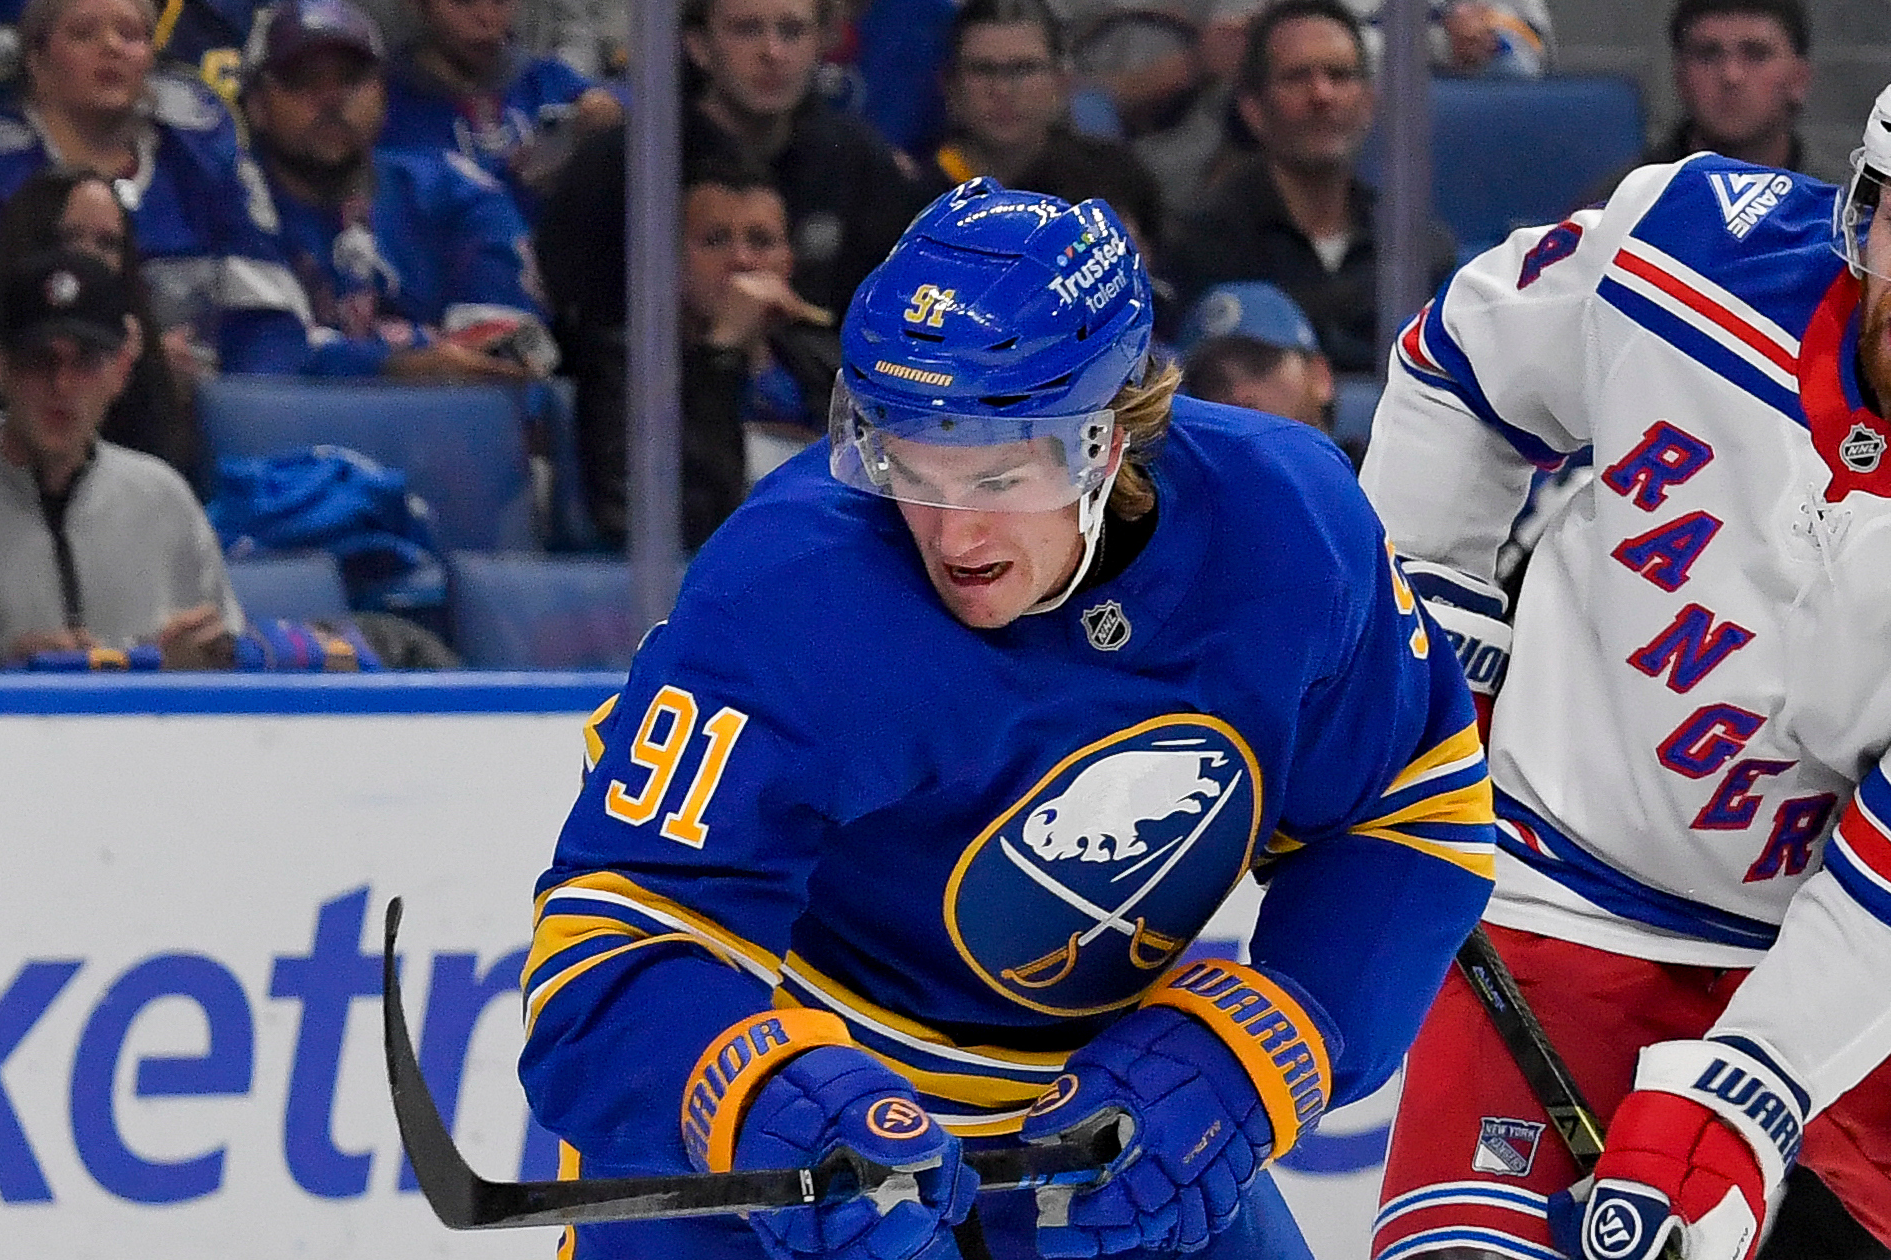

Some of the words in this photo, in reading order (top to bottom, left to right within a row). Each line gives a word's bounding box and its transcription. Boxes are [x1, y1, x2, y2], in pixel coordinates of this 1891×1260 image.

[1727, 175, 1793, 239] GAME
[1047, 226, 1127, 304] Trusted
[904, 284, 956, 328] 91
[1086, 267, 1127, 314] talent
[875, 360, 953, 387] WARRIOR
[605, 684, 749, 850] 91
[1485, 1122, 1507, 1135] NEW
[1509, 1126, 1536, 1141] YORK
